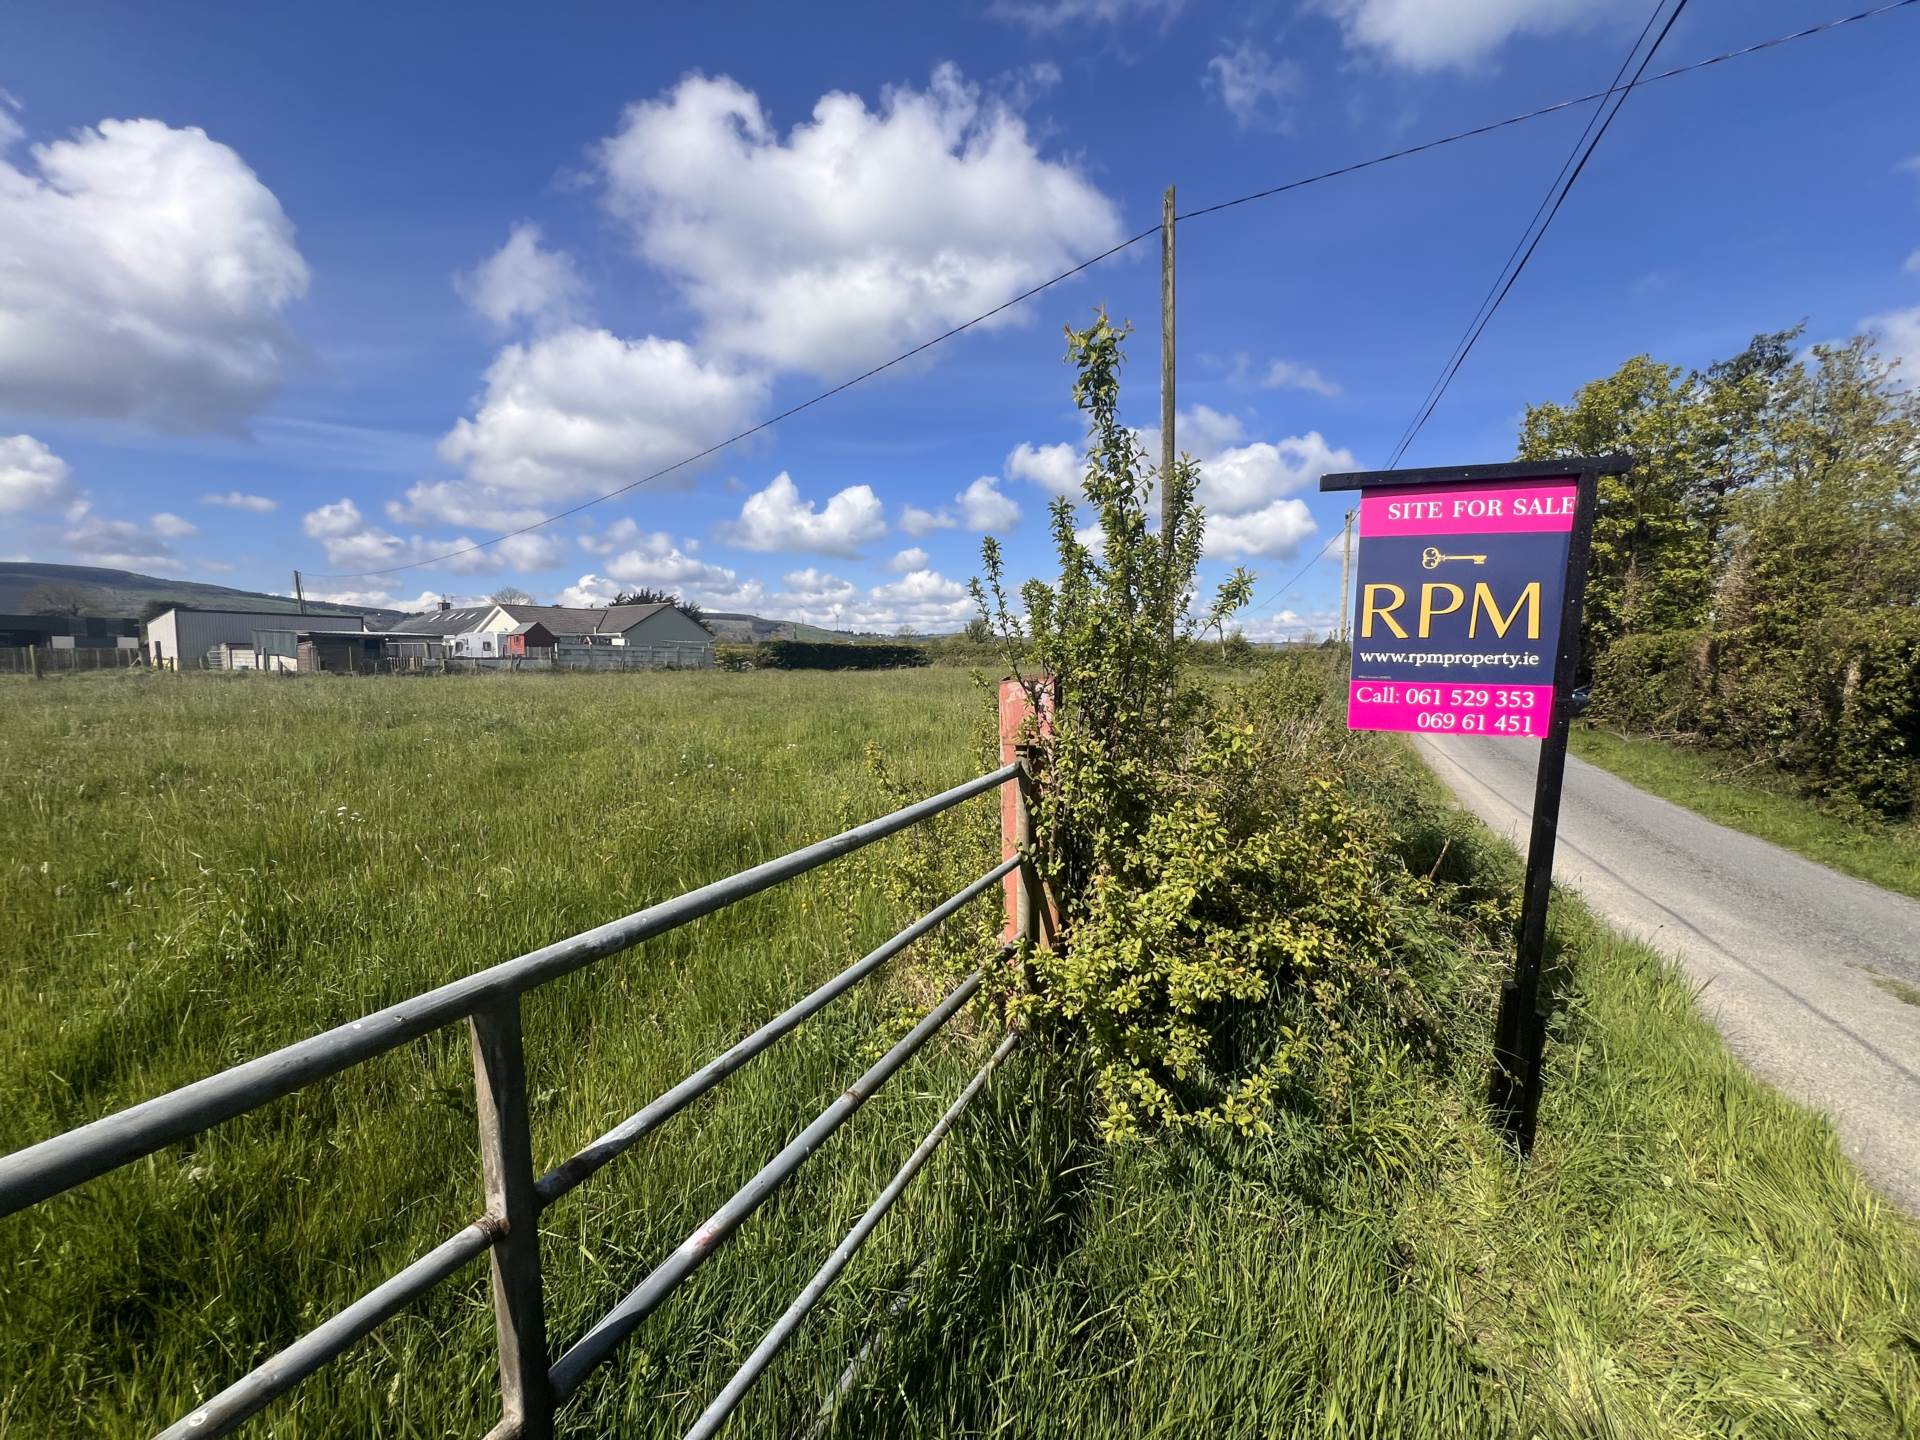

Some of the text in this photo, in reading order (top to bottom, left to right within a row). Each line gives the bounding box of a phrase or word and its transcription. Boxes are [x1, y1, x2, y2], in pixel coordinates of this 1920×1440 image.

[1388, 496, 1576, 520] SITE FOR SALE
[1361, 582, 1541, 640] RPM
[1360, 651, 1540, 668] www.rpmproperty.ie
[1356, 686, 1535, 709] Call: 061 529 353
[1417, 712, 1532, 733] 069 61 451
